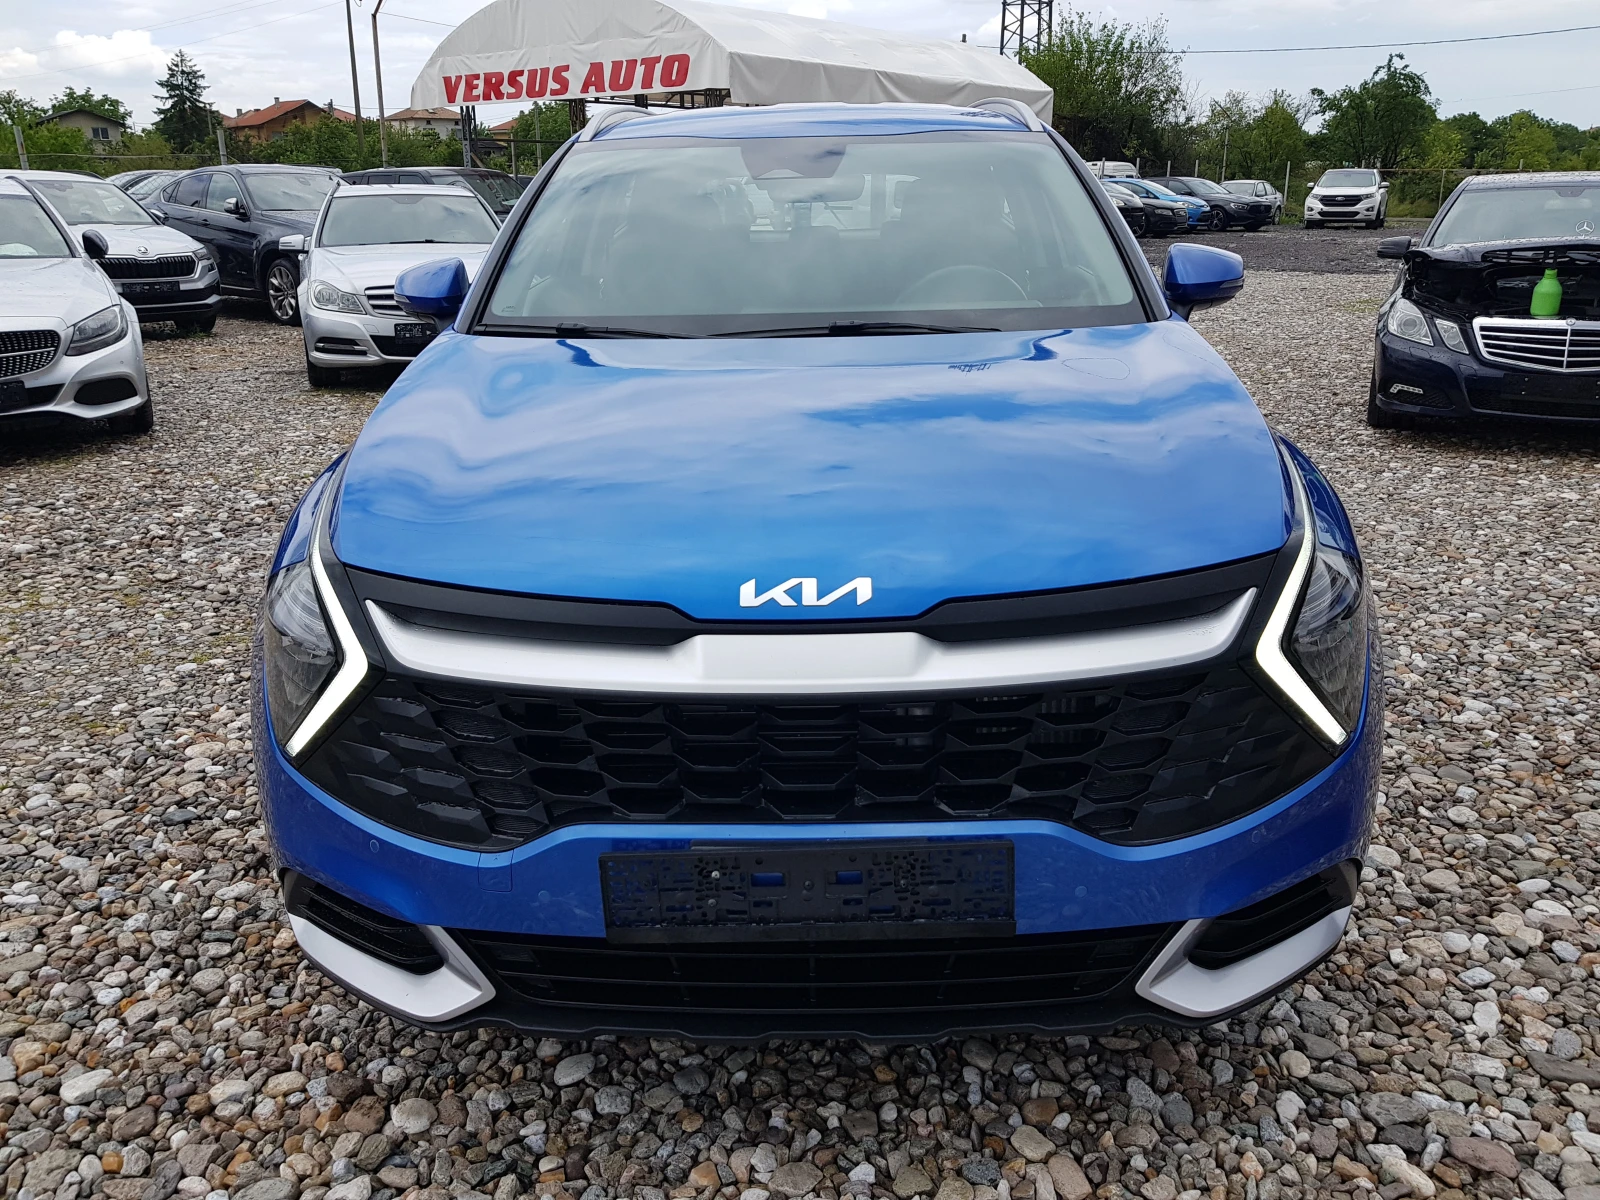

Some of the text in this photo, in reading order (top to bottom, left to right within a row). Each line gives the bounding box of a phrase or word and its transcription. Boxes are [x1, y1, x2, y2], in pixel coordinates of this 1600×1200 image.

[442, 53, 690, 103] VERSUS AUTO
[739, 577, 872, 607] KIA
